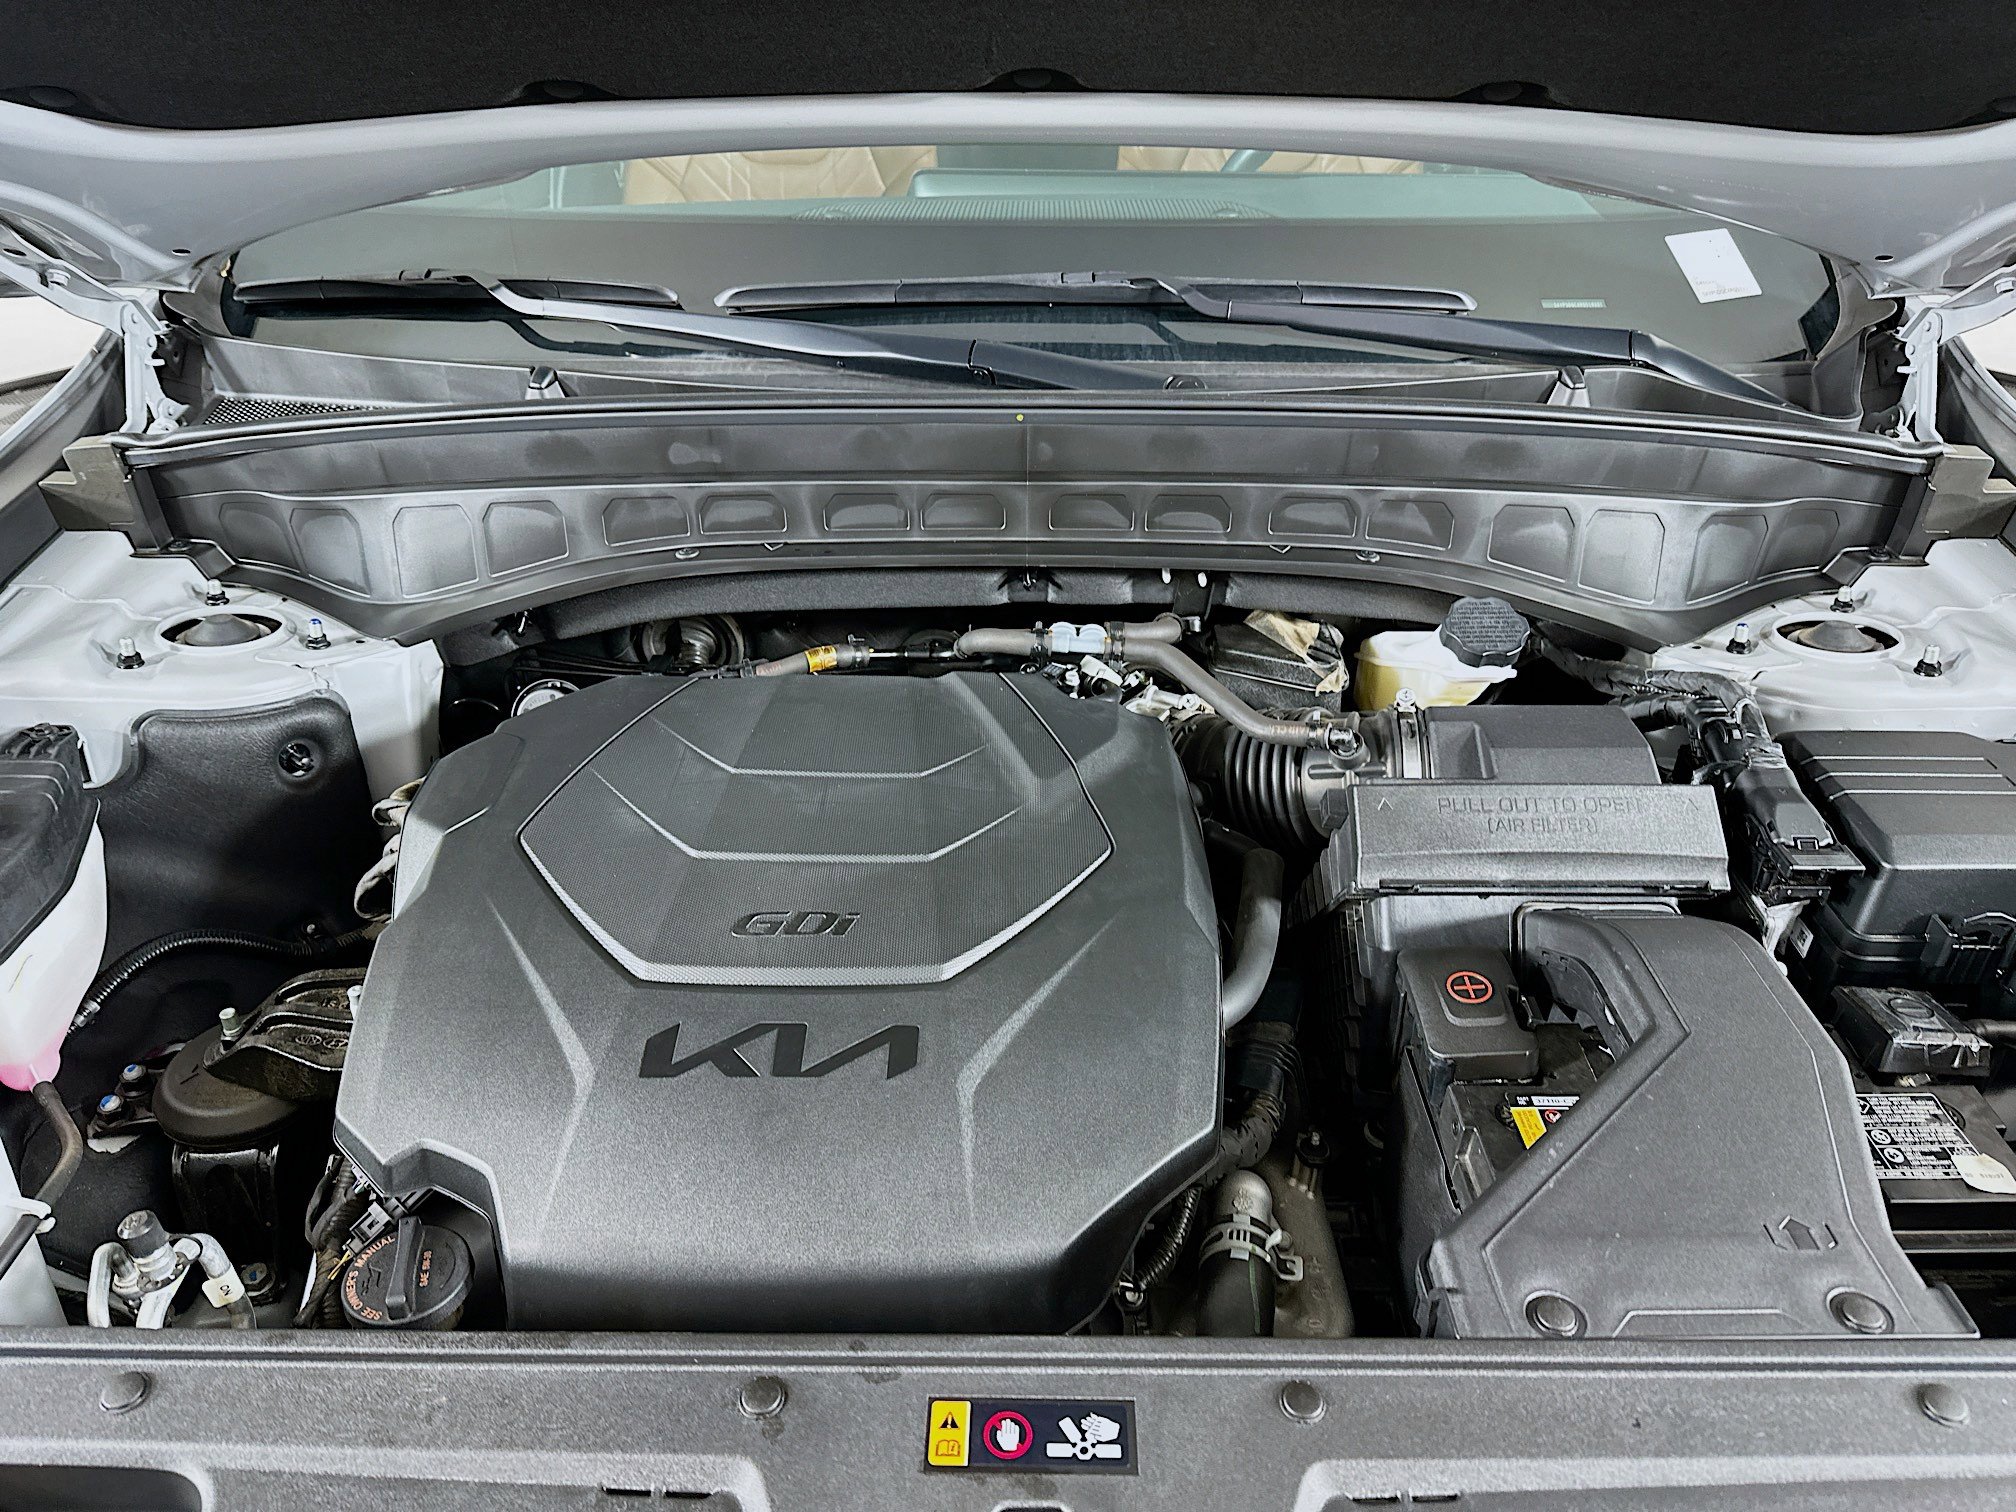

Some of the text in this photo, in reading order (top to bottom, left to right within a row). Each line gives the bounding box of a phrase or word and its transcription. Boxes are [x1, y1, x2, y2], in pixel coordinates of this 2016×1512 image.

[1437, 797, 1642, 814] PULL OUT TO OPEN
[1486, 817, 1599, 834] (AIR FILTER)
[731, 911, 861, 937] GDi
[638, 1020, 920, 1080] KIA
[346, 1235, 396, 1321] SEE OWNER'S MANUAL
